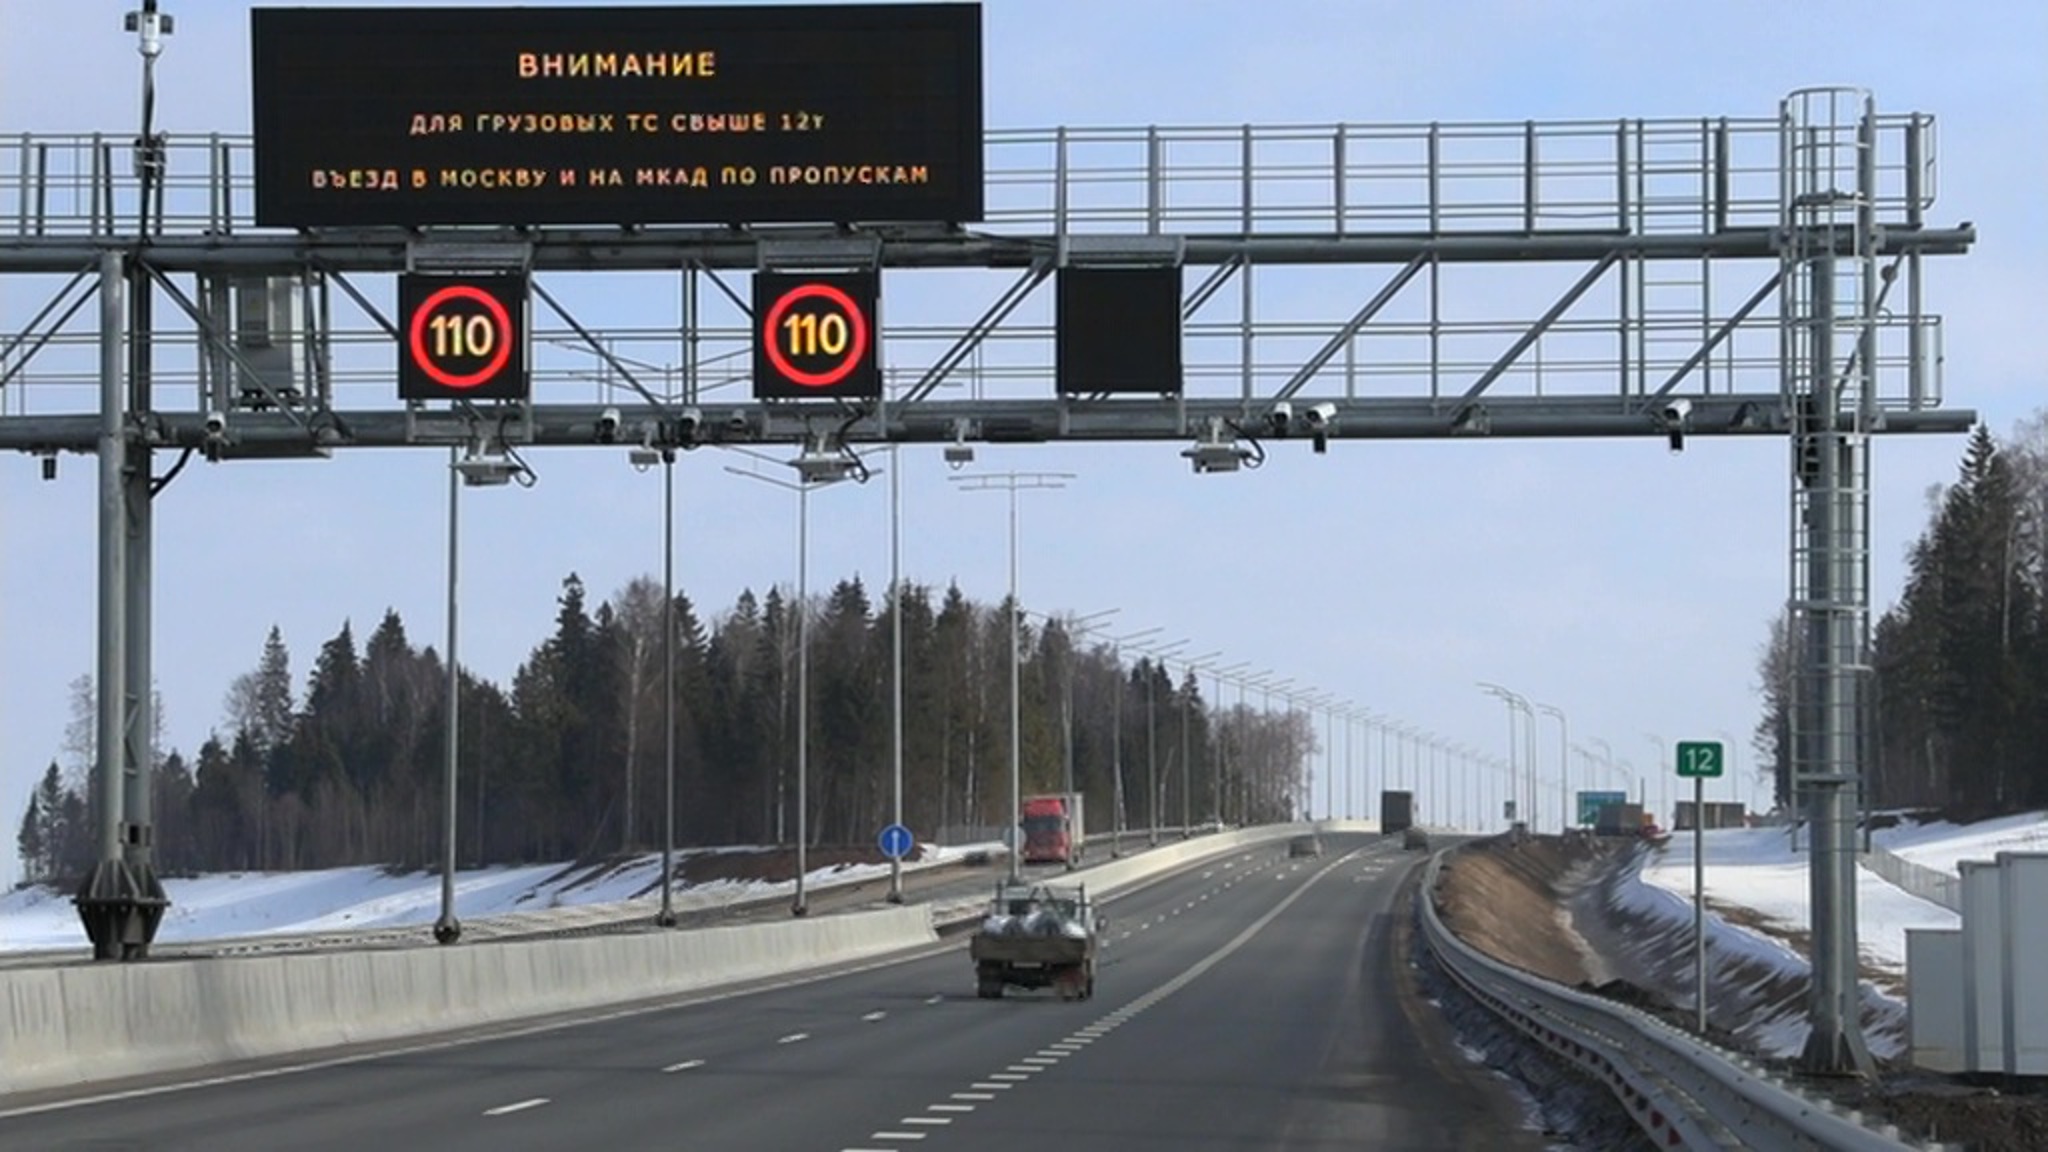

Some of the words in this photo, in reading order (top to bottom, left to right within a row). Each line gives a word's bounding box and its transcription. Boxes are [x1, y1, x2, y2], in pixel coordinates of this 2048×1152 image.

[518, 51, 716, 78] ВНИМАНИЕ
[410, 114, 463, 135] ДЛЯ
[477, 113, 613, 133] ГРУЗОВЫХ
[626, 113, 658, 133] ТС
[671, 112, 766, 132] СВЫШЕ
[312, 169, 399, 189] ВЪЕЗД
[411, 169, 427, 188] В
[440, 168, 547, 188] МОСКВУ
[559, 169, 576, 186] И
[589, 168, 623, 186] НА
[636, 167, 708, 187] МКАД
[721, 166, 757, 185] ПО
[769, 165, 928, 185] ПРОПУСКАМ
[429, 314, 494, 356] 110
[783, 312, 848, 355] 110
[1685, 748, 1714, 771] 12
